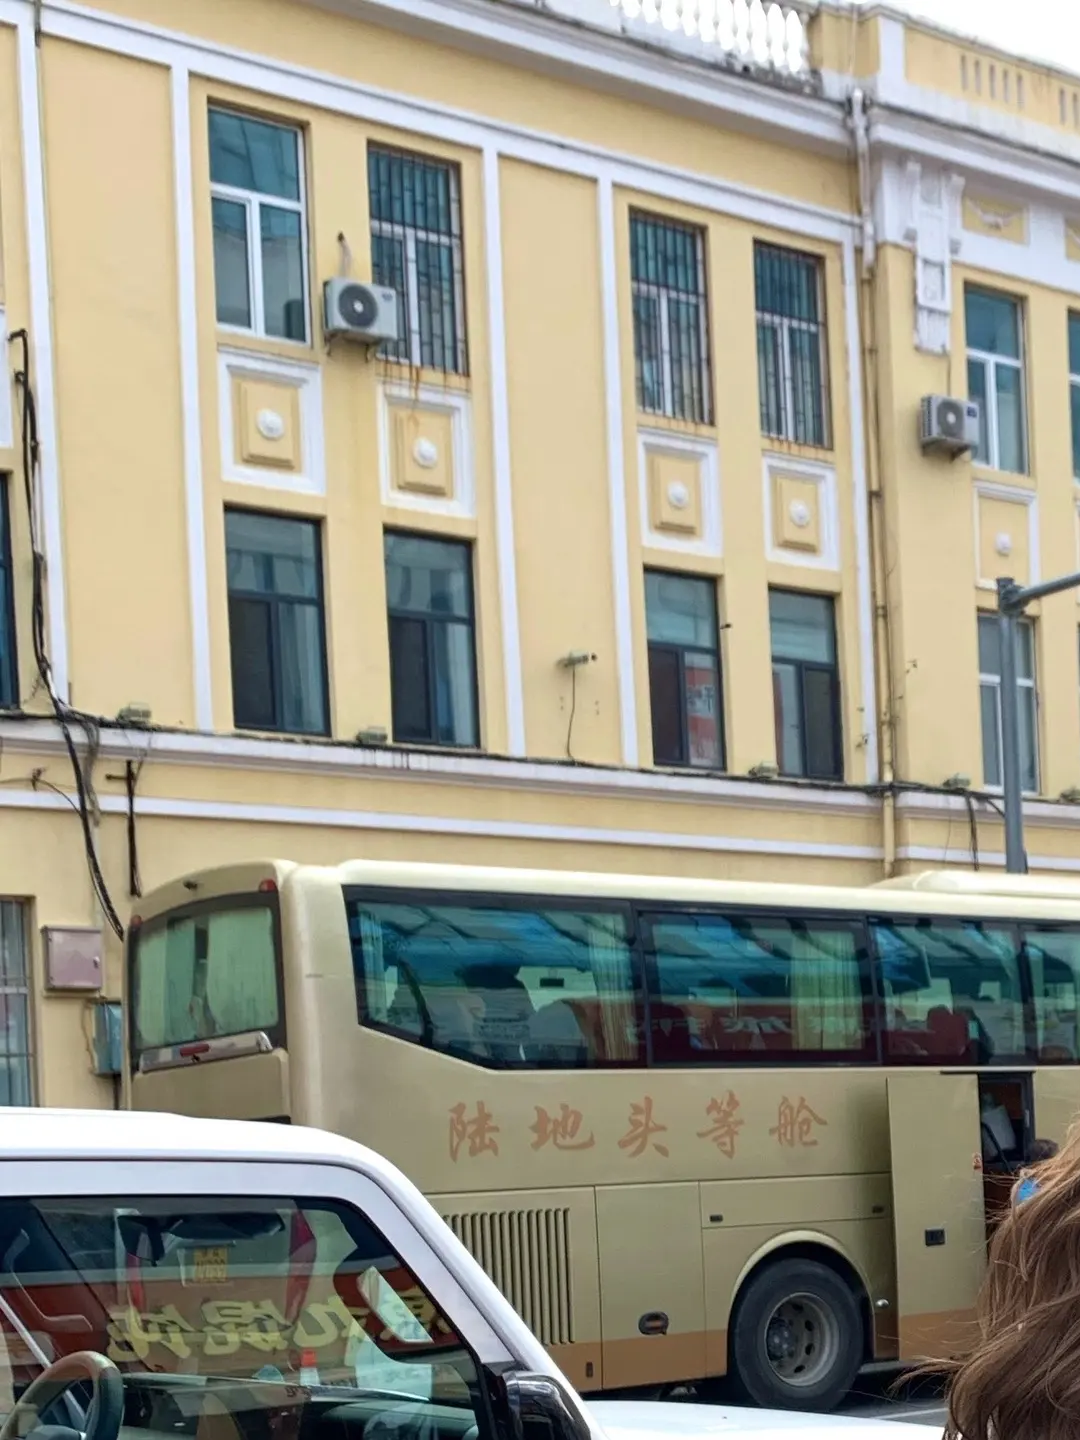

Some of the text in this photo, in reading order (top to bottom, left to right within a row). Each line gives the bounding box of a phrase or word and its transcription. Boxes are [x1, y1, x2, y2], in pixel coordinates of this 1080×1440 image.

[447, 1089, 828, 1163] 陆地头等舱
